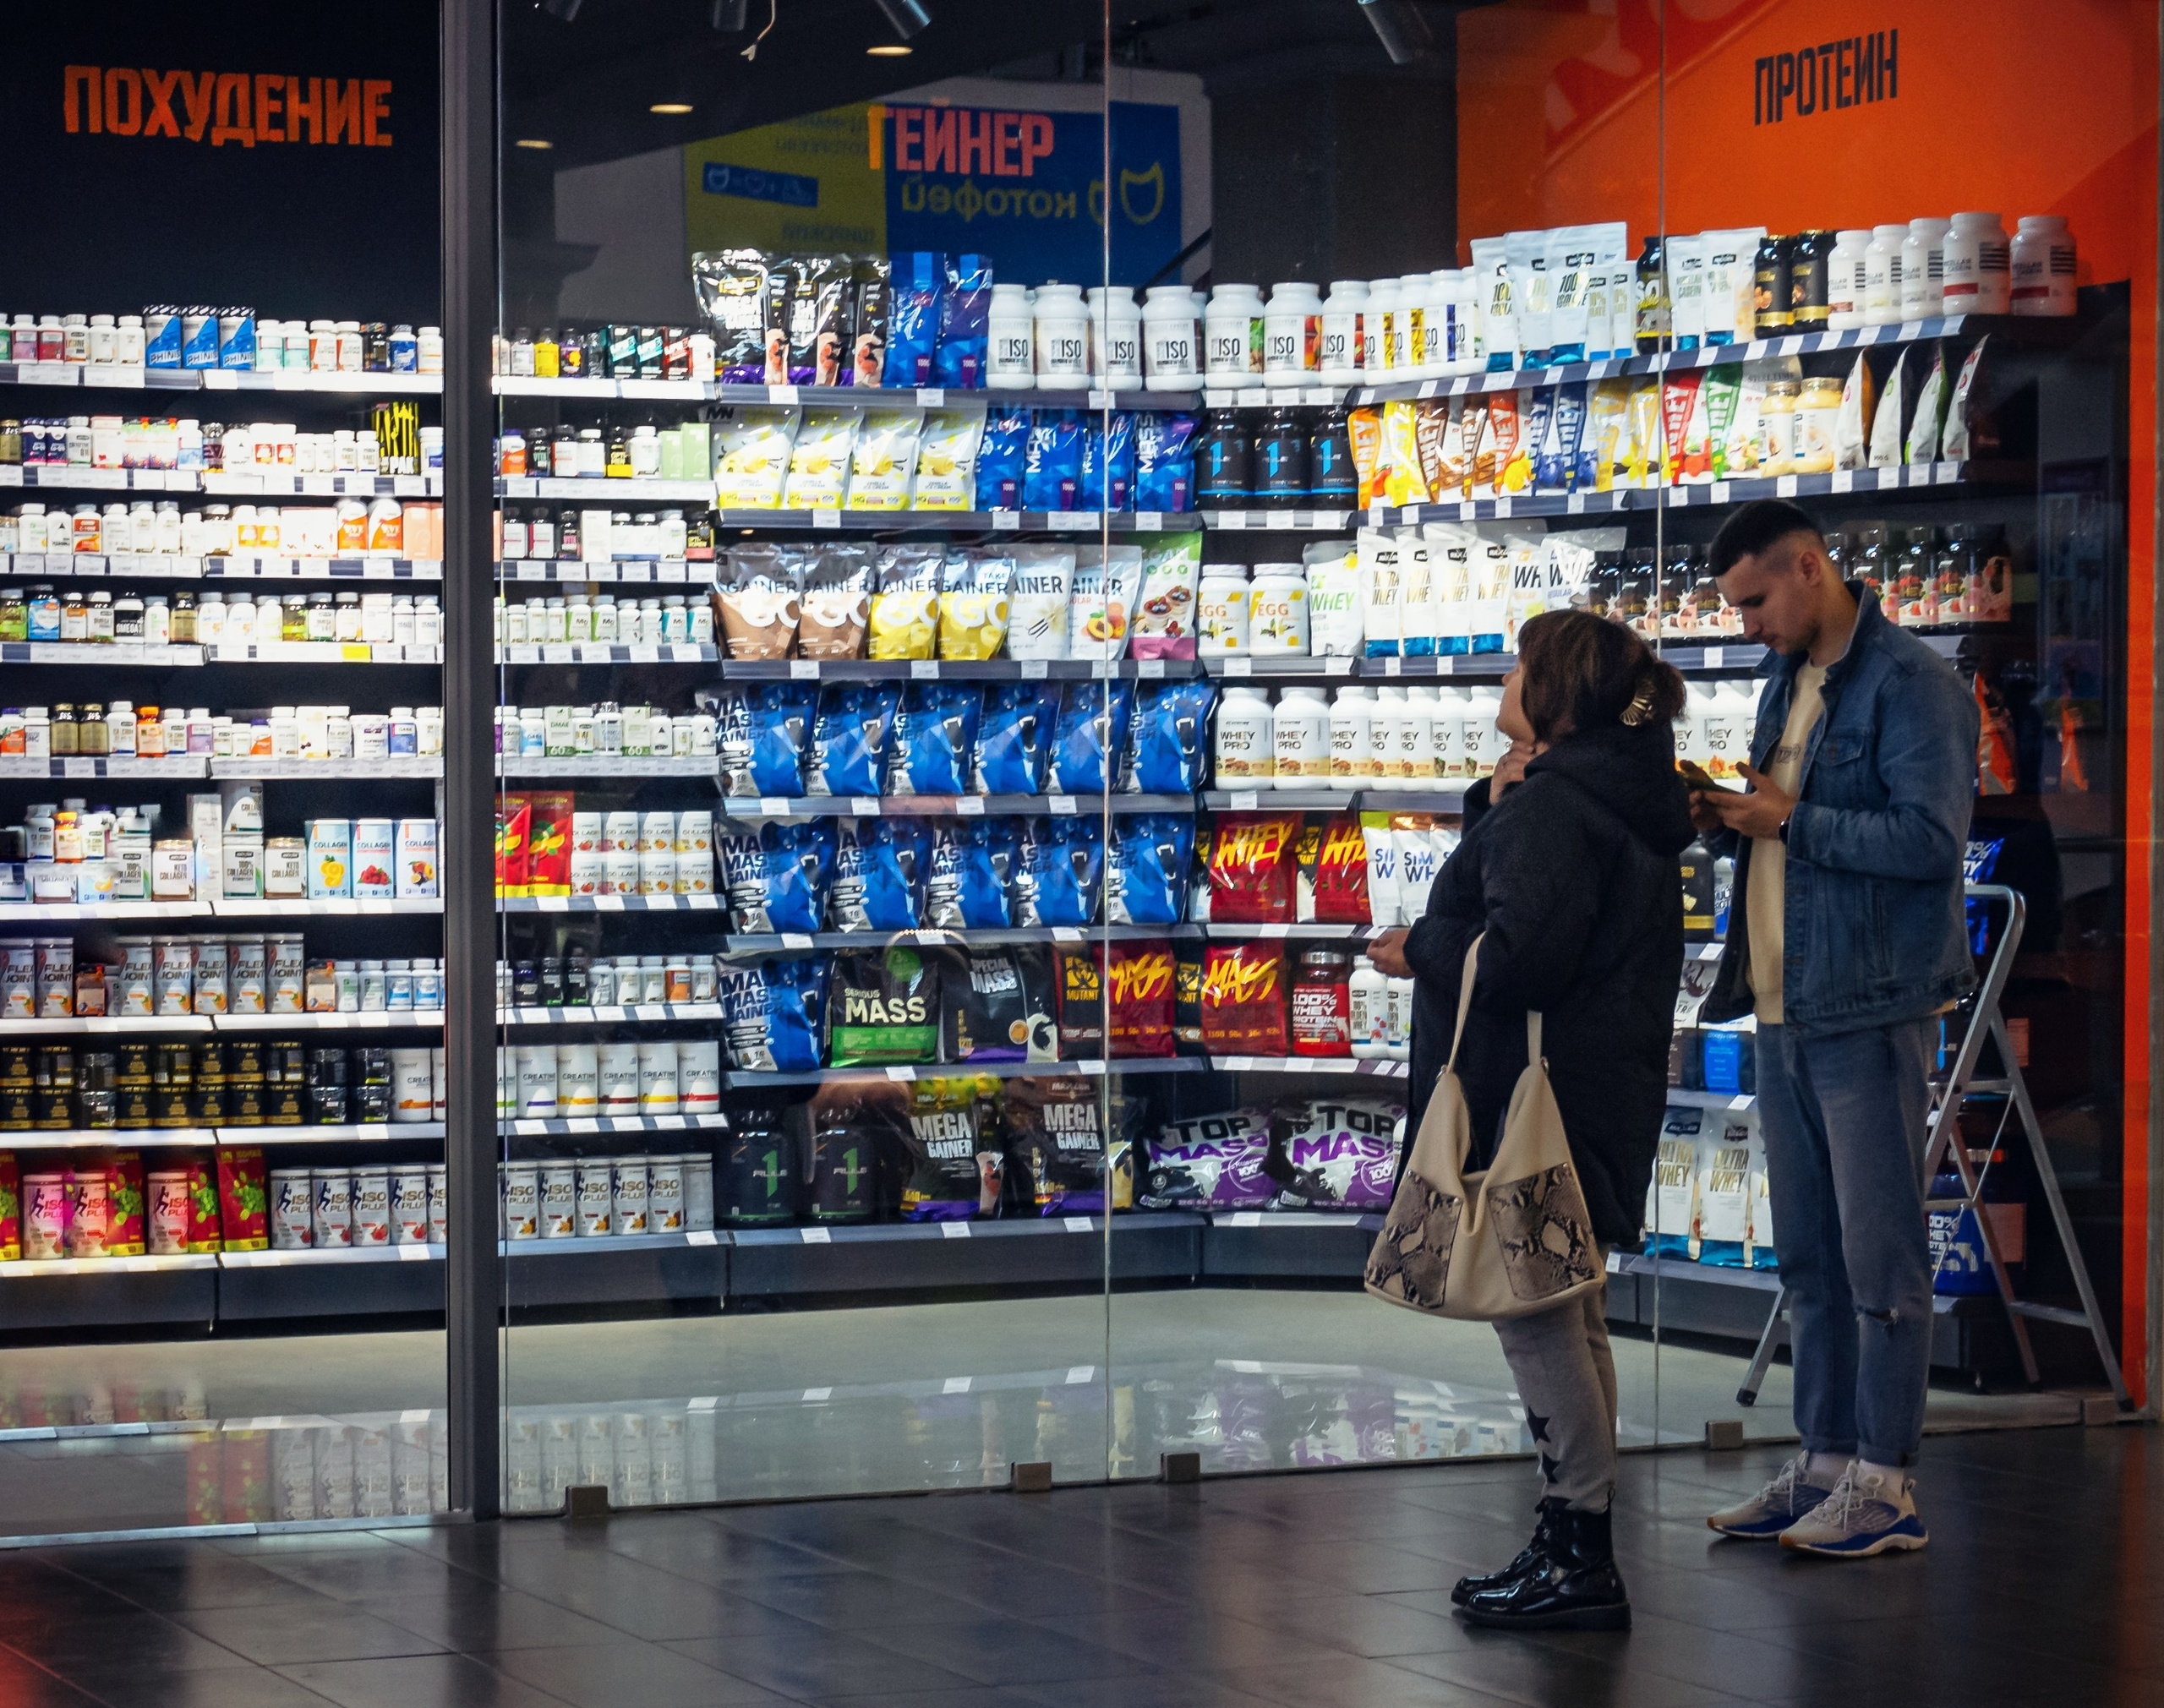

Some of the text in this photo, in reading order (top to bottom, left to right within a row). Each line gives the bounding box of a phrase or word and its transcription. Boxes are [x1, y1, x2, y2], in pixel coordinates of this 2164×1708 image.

[1754, 29, 1899, 126] ПРОТЕИН
[64, 65, 392, 147] ПОХУДЕНИЕ
[868, 96, 1054, 177] ГЕЙНЕР
[1425, 328, 1437, 346] SO
[1456, 324, 1466, 342] SO
[1009, 340, 1029, 357] ISO
[1061, 340, 1081, 357] ISO
[1114, 341, 1134, 359] ISO
[1166, 341, 1188, 358] ISO
[1218, 338, 1240, 356] ISO
[1274, 336, 1294, 354] ISO
[1325, 335, 1345, 353] ISO
[1364, 337, 1375, 353] SO
[1210, 441, 1221, 477] 1
[1266, 440, 1280, 477] 1
[1320, 439, 1331, 476] 1
[883, 580, 938, 593] AINER
[1014, 576, 1063, 595] AINER
[1072, 577, 1123, 596] AINER
[1258, 603, 1289, 616] EGG
[1311, 593, 1354, 611] WHEY
[1220, 731, 1255, 740] WHEY
[1276, 730, 1308, 740] WHEY
[1372, 731, 1390, 740] HEY
[1401, 732, 1419, 740] HEY
[1434, 732, 1451, 741] HEY
[1465, 731, 1484, 741] HEY
[1708, 729, 1733, 738] HEY
[550, 747, 566, 756] 60
[1224, 741, 1250, 750] PRO
[1278, 741, 1302, 750] PRO
[1402, 742, 1414, 750] RO
[1465, 742, 1478, 751] RO
[1215, 821, 1294, 868] WHEY
[271, 870, 299, 878] COLLAGEN
[970, 969, 1017, 994] MASS
[1200, 957, 1278, 1007] MASS
[844, 988, 880, 999] SERIOUS
[1067, 989, 1099, 1001] MUTANT
[1293, 994, 1337, 1006] 100%
[845, 996, 926, 1023] MASS
[1293, 1006, 1336, 1016] WHEY
[910, 1112, 972, 1141] MEGA
[1043, 1104, 1097, 1132] MEGA
[1317, 1105, 1395, 1136] TOP
[1176, 1116, 1251, 1143] TOP
[927, 1139, 972, 1159] GAINER
[1057, 1132, 1100, 1150] GAINER
[1292, 1132, 1393, 1166] MAS
[1713, 1149, 1749, 1170] ULTRA
[762, 1149, 779, 1198] 1
[843, 1148, 858, 1195] 1
[549, 1185, 572, 1195] ISO
[585, 1183, 609, 1193] ISO
[621, 1181, 645, 1191] ISO
[654, 1180, 679, 1190] ISO
[1709, 1170, 1746, 1192] WHEY
[362, 1192, 386, 1203] ISO
[510, 1186, 535, 1196] ISO
